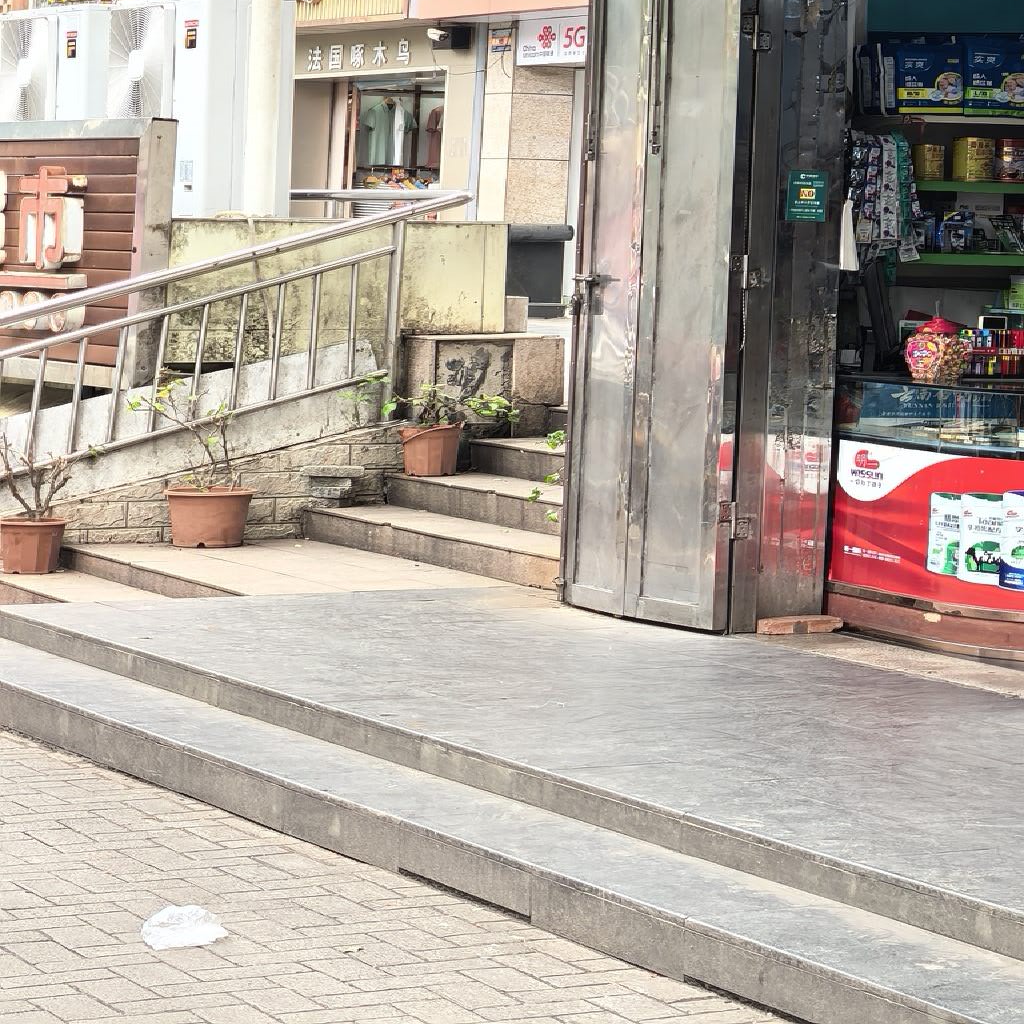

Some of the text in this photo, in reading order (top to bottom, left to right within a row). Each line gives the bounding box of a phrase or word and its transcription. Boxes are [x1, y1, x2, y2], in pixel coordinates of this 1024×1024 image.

[563, 26, 586, 49] 5G
[307, 38, 411, 71] 法国啄木鸟
